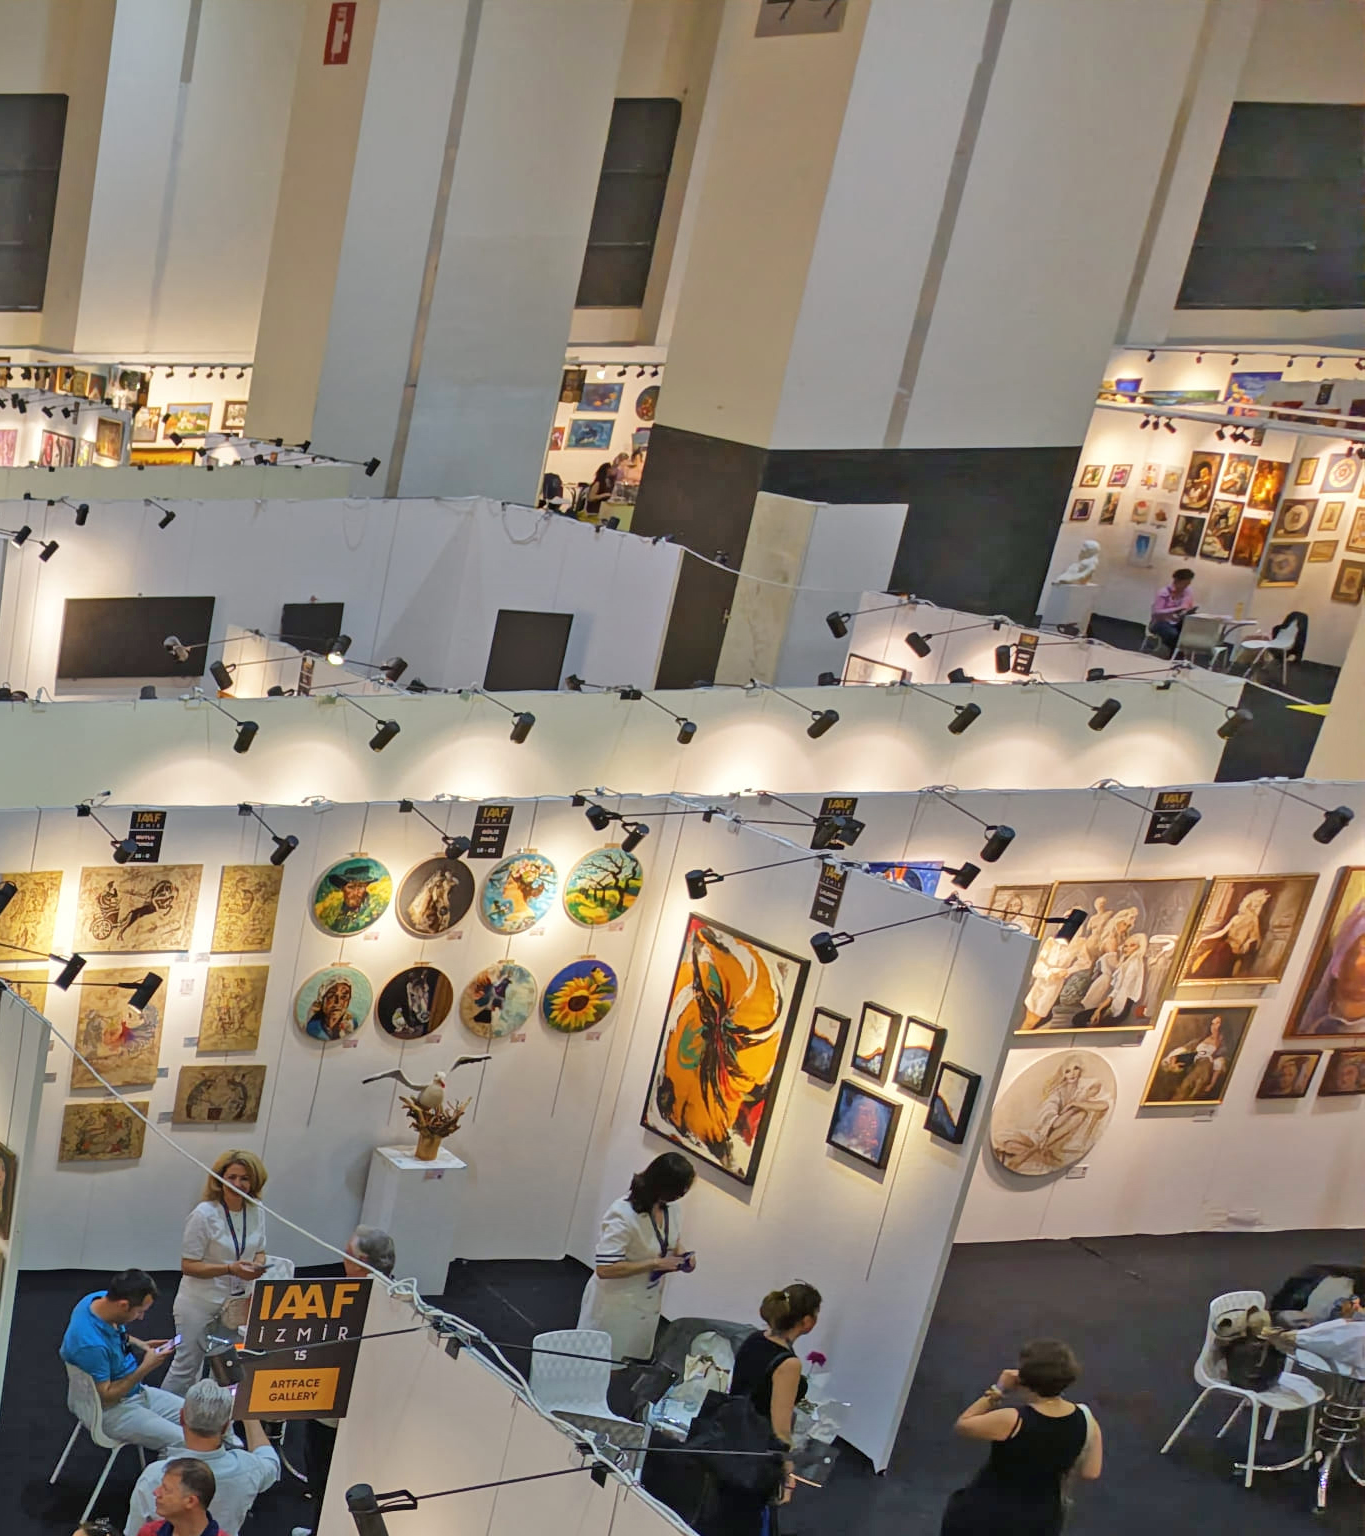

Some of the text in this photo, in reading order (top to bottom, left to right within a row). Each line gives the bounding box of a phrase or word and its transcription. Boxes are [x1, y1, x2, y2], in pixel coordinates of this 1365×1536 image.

[137, 812, 162, 823] IAAF
[483, 807, 509, 818] IAAF
[259, 1283, 360, 1320] IAAF
[258, 1324, 348, 1342] İZMİR
[294, 1350, 307, 1360] 15
[270, 1379, 321, 1389] ARTFACE
[269, 1391, 318, 1402] GALLERY
